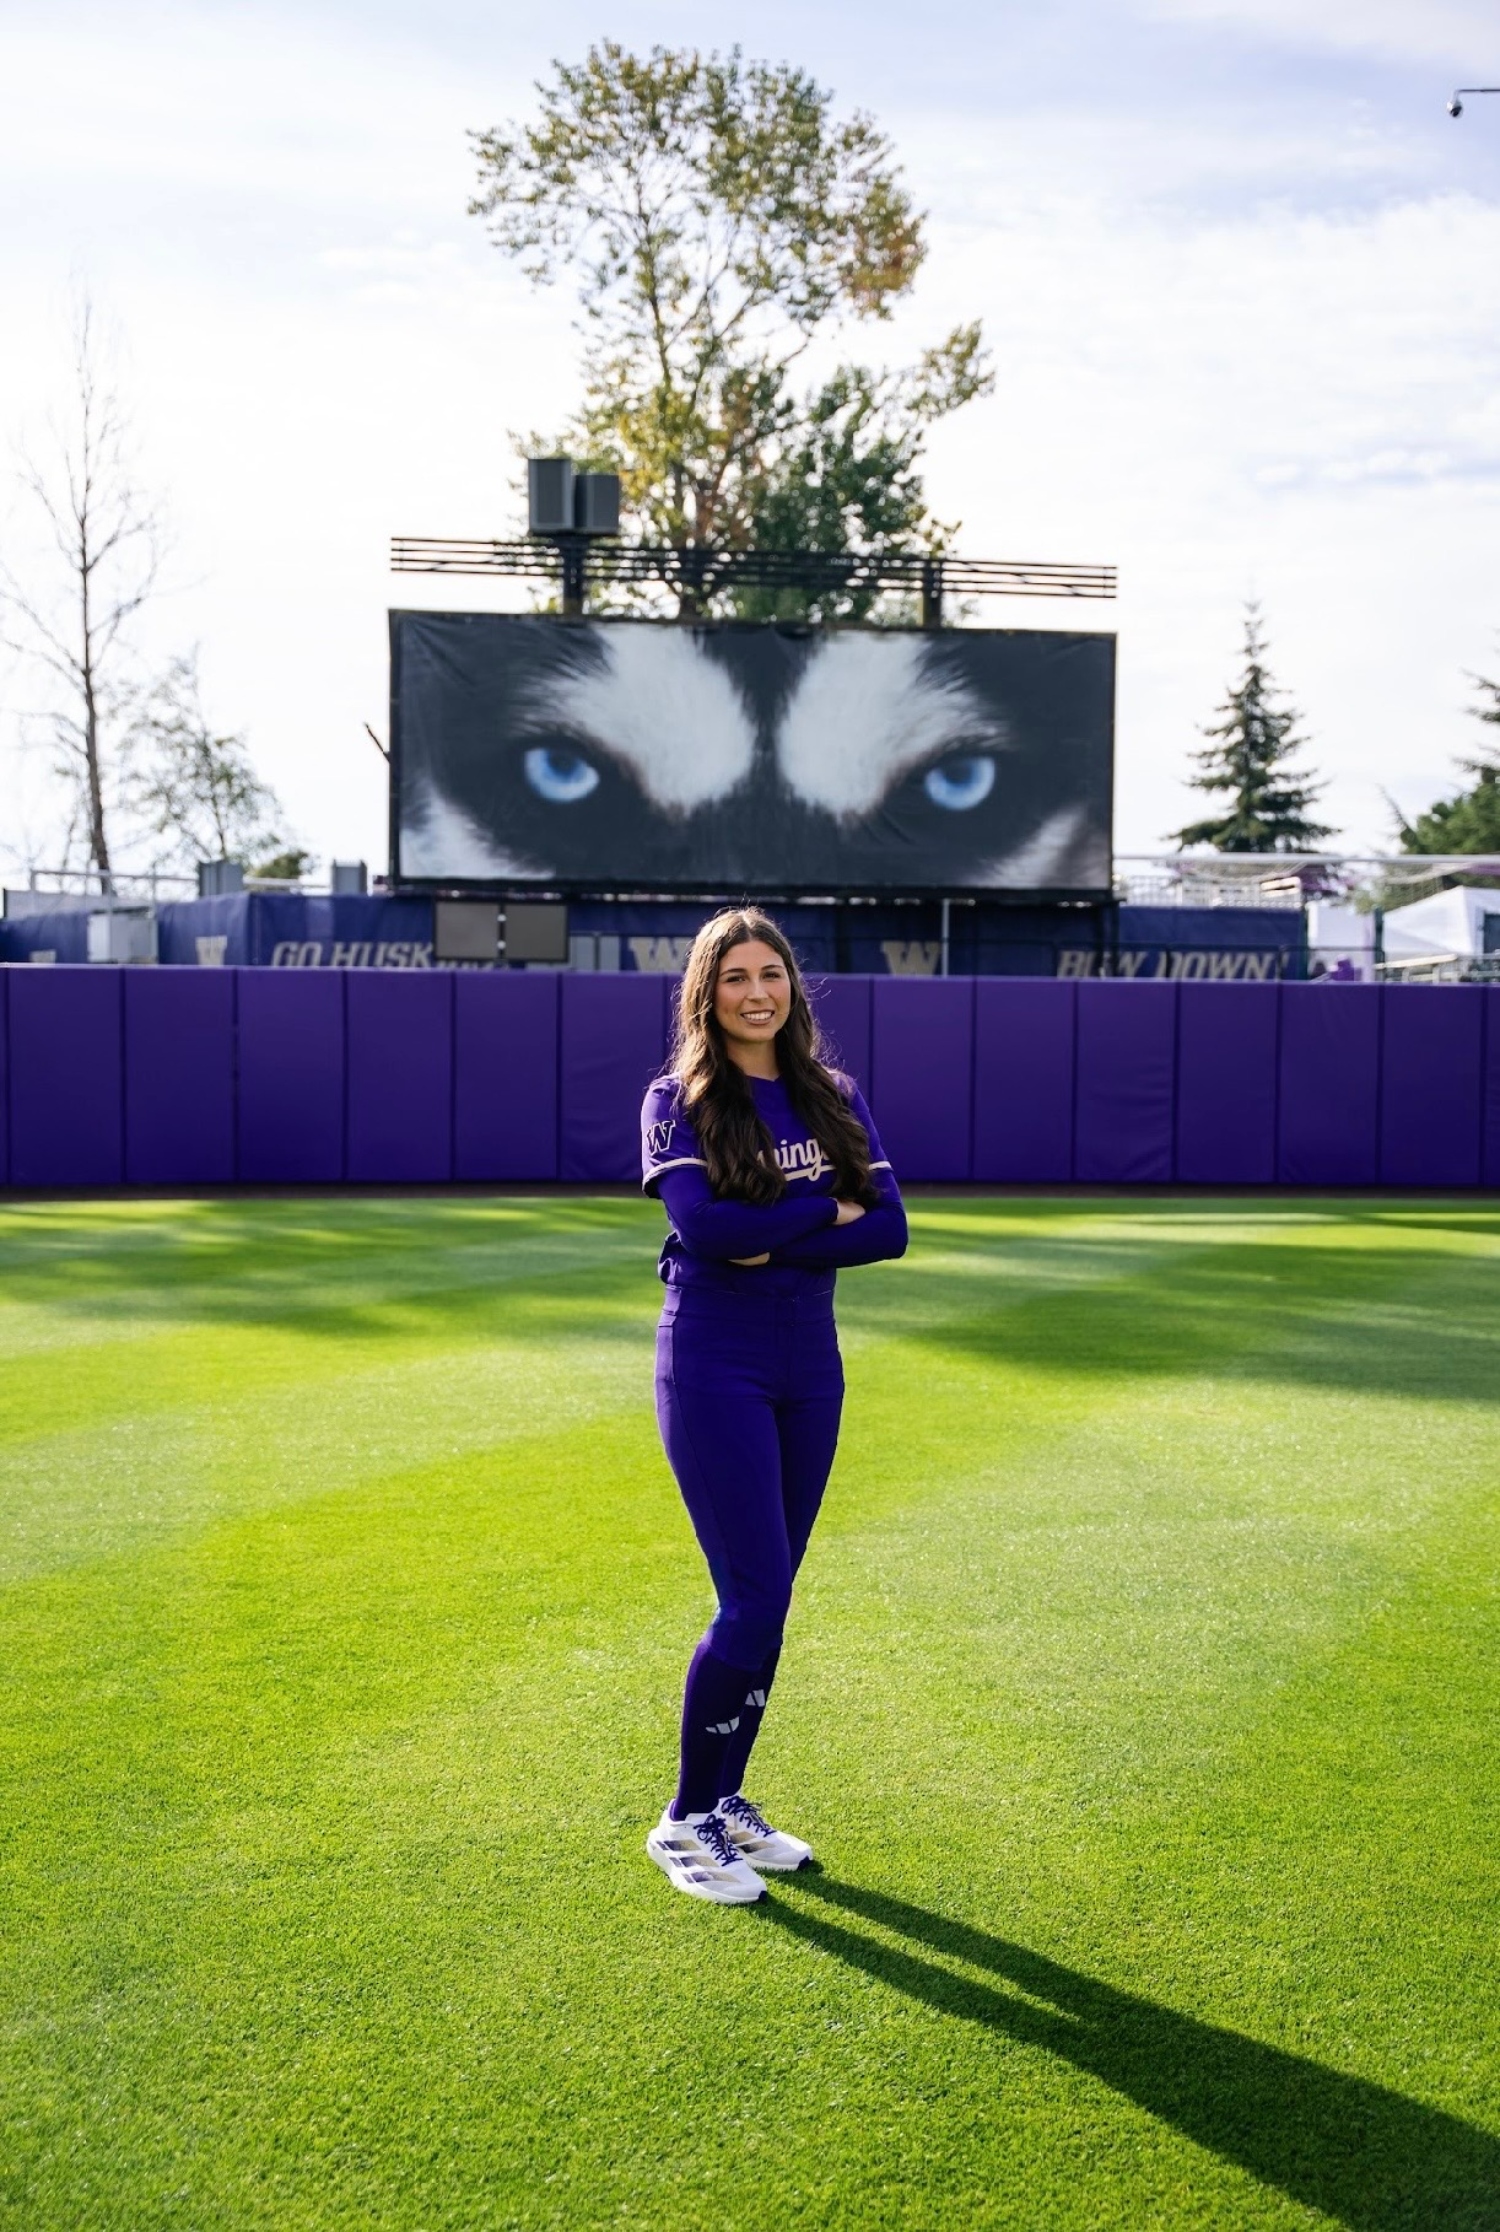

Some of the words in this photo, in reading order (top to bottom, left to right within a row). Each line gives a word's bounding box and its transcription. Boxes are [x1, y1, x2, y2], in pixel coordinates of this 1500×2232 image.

[270, 941, 323, 969] GO
[328, 942, 496, 970] HUSK
[627, 936, 693, 973] W
[881, 940, 941, 976] W
[646, 1119, 676, 1157] W
